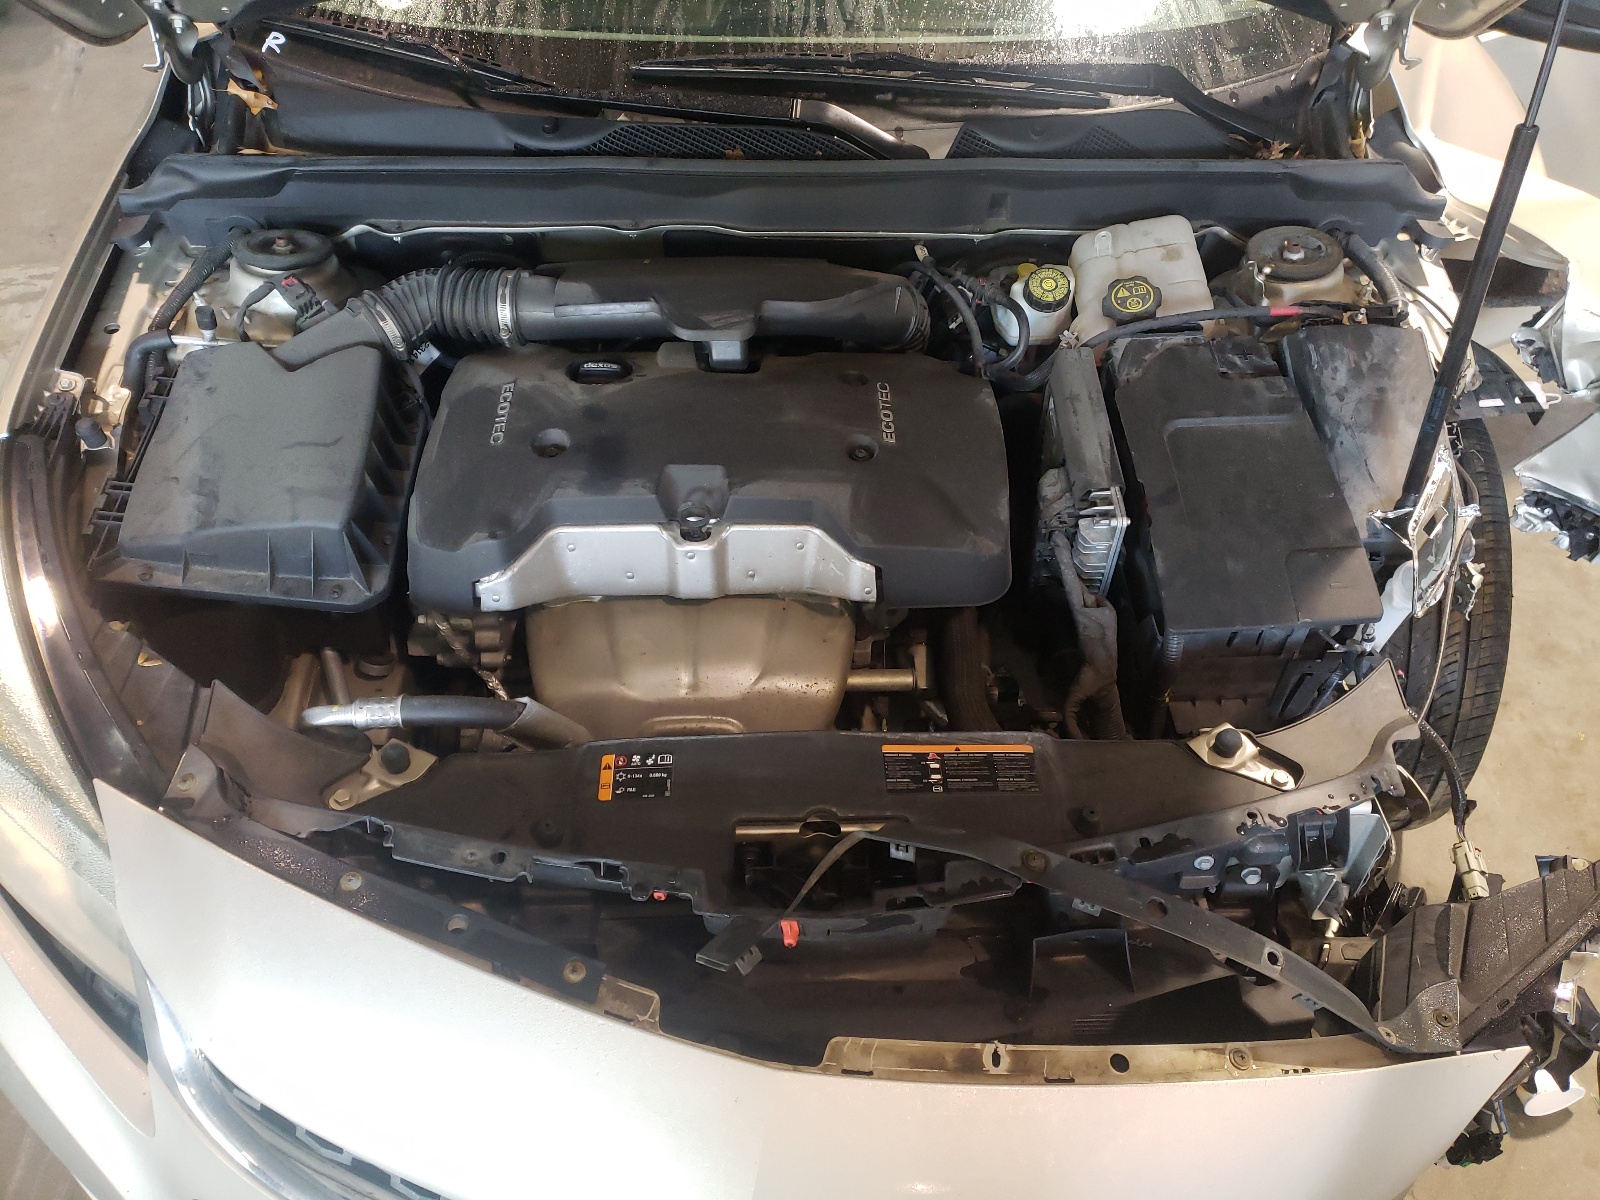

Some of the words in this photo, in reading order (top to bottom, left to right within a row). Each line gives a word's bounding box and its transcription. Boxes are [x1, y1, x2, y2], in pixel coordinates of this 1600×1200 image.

[261, 31, 286, 53] R
[489, 382, 515, 445] ECOTEC
[876, 381, 896, 444] ECOTEC
